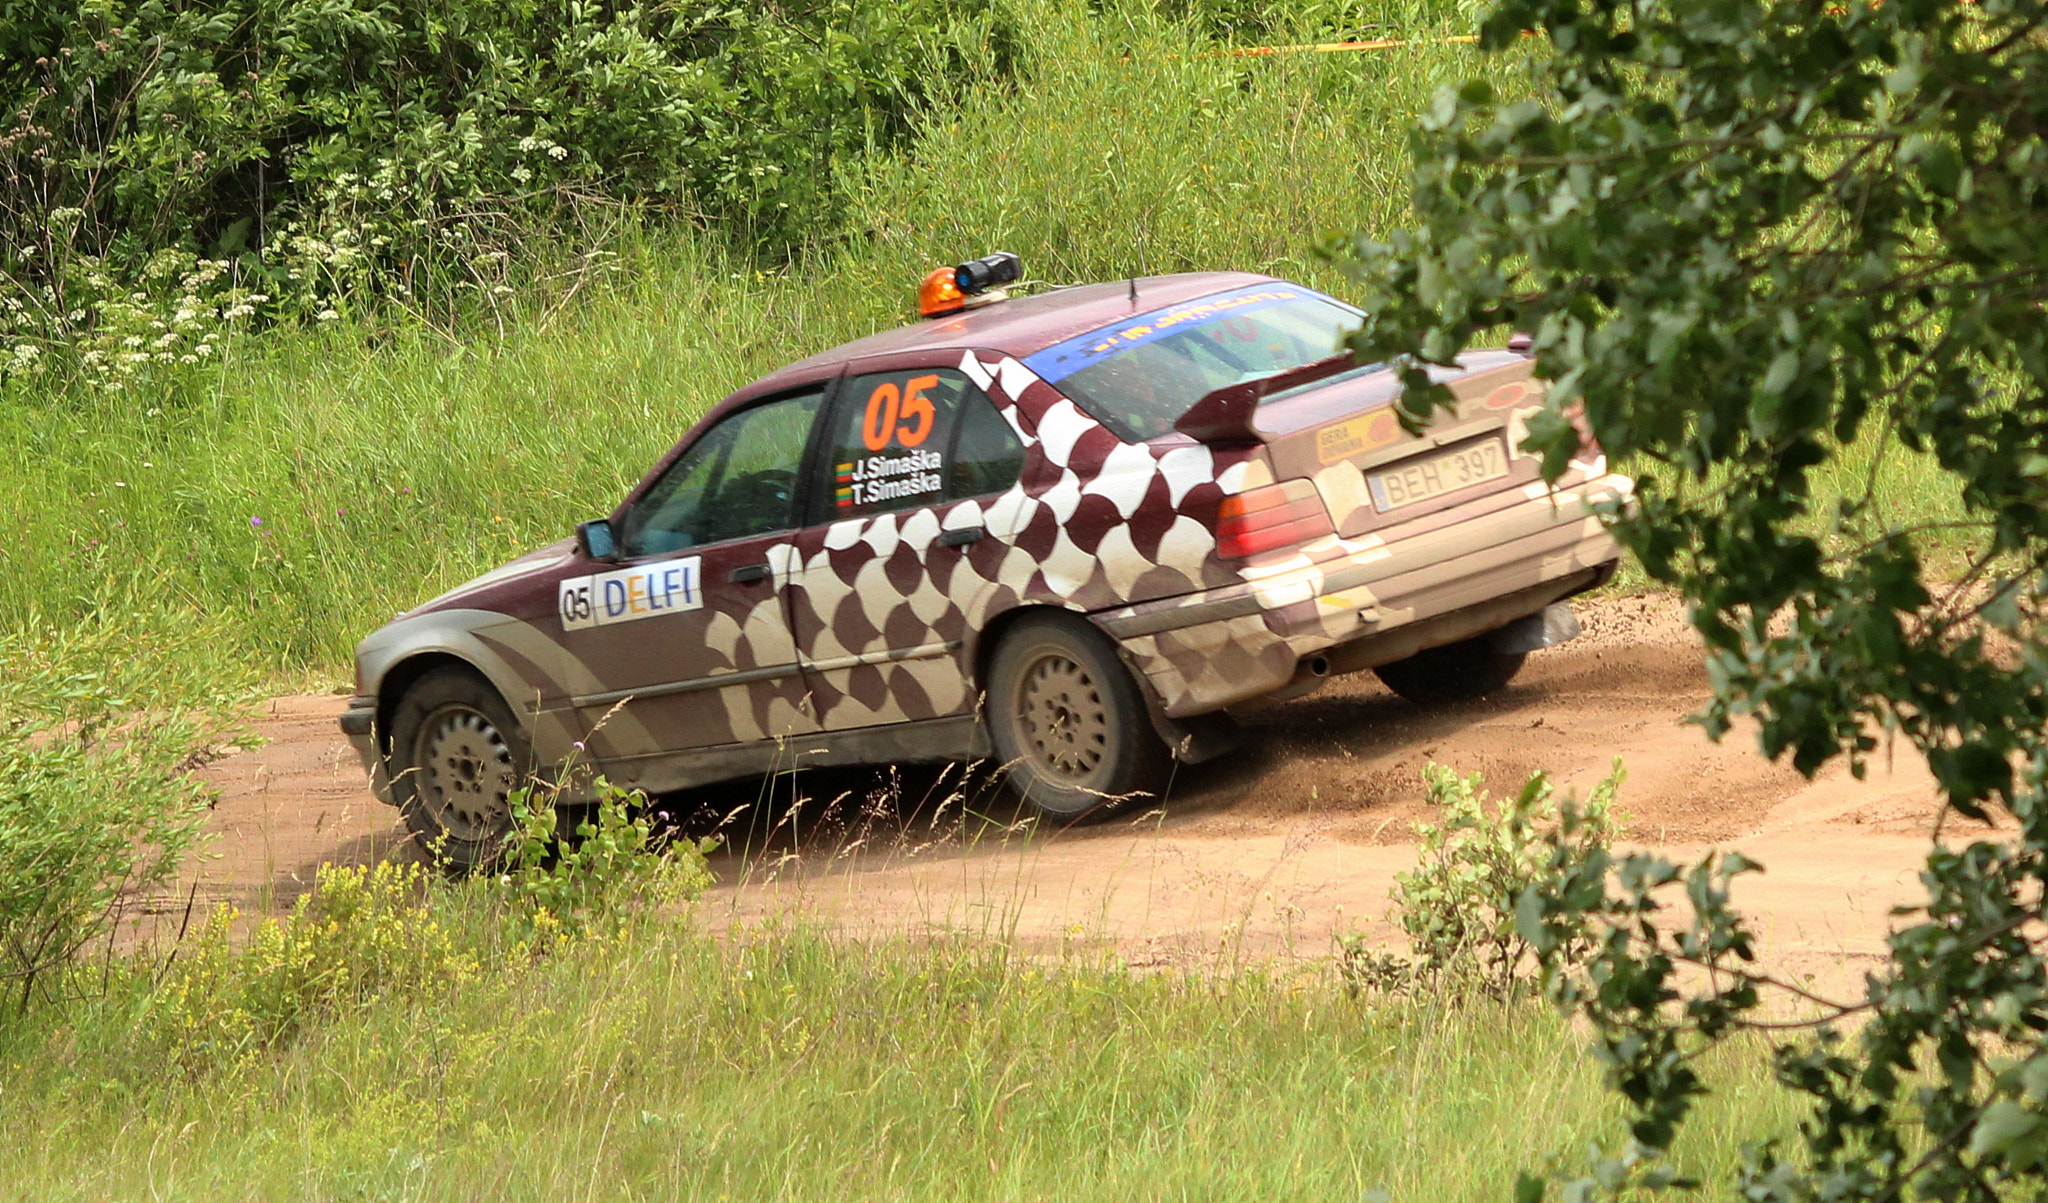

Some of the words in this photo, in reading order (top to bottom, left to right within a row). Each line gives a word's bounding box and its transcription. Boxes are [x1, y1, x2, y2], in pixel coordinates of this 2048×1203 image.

[862, 374, 939, 451] 05
[851, 472, 942, 505] T.Simaška
[852, 449, 942, 481] J.Simaška
[1385, 463, 1443, 504] BEH
[1455, 446, 1496, 482] 397
[564, 587, 590, 622] 05
[605, 567, 691, 617] DELFI
